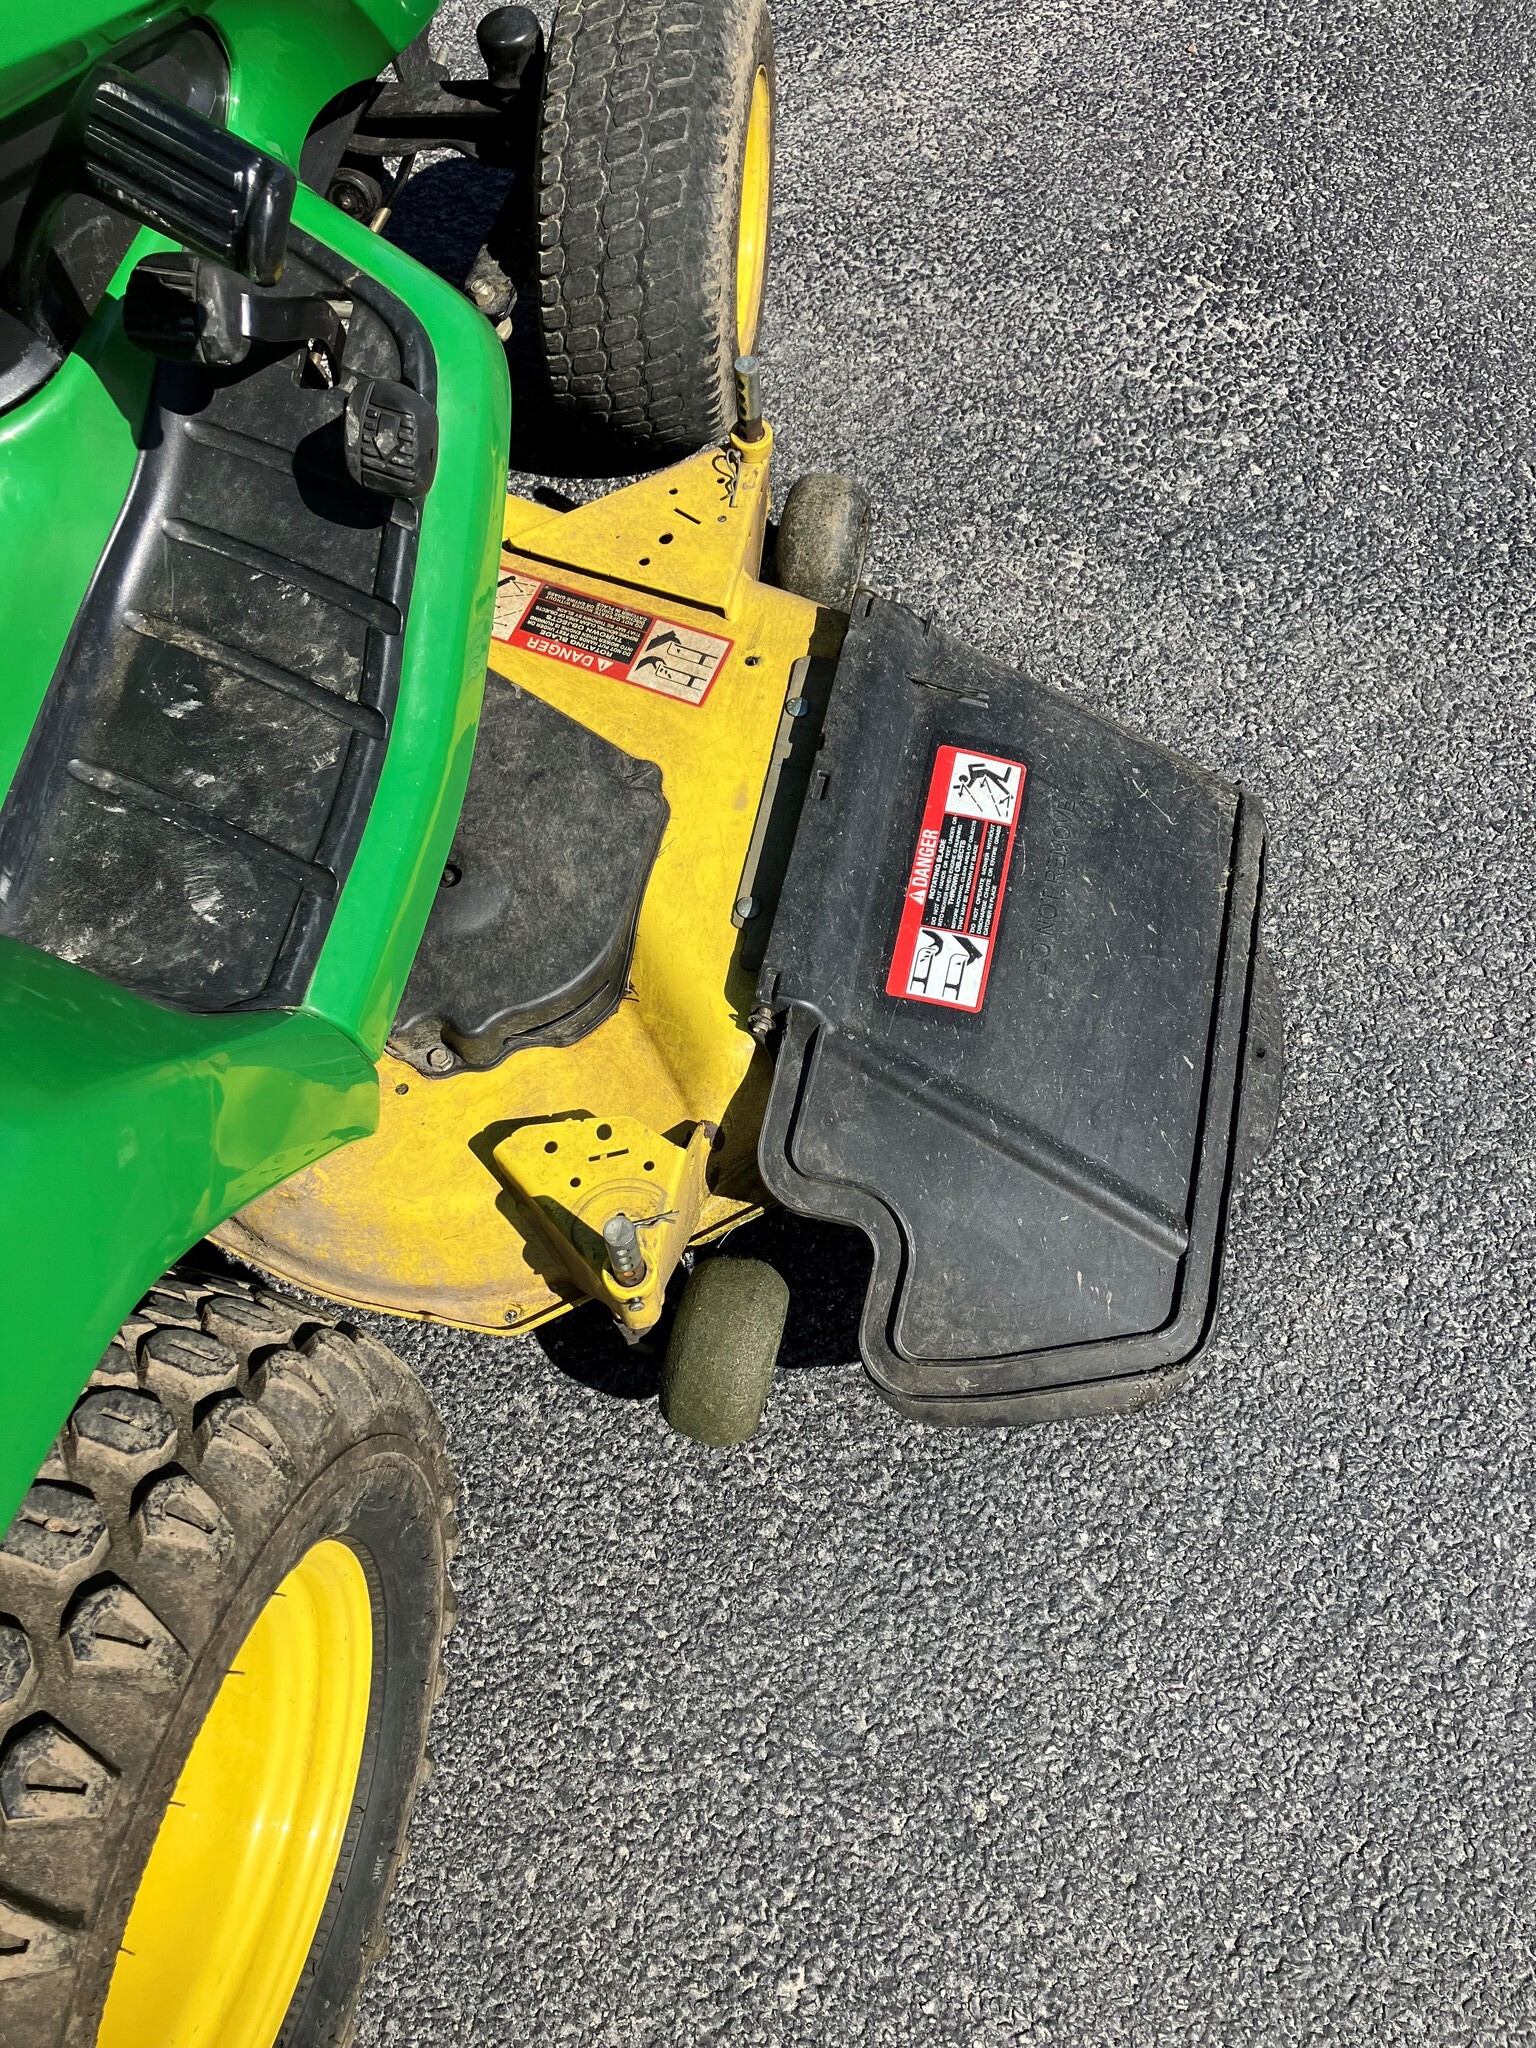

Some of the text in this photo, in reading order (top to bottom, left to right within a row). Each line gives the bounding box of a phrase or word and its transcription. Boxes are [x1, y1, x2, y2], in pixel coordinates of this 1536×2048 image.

[534, 604, 558, 615] OBJECTS
[571, 603, 593, 613] MOWER
[595, 602, 615, 611] PLACE
[529, 615, 554, 626] RUNNING
[565, 614, 579, 622] AREA
[582, 615, 606, 625] THROWN
[593, 610, 621, 622] OPERATE
[535, 622, 555, 631] UNDER
[578, 619, 596, 628] CLEAR
[620, 618, 634, 626] NOT
[544, 614, 623, 642] THROWN OBJECTS
[555, 628, 569, 636] FEET
[560, 625, 581, 635] ENGINE
[626, 629, 641, 637] THAT
[578, 636, 598, 645] HANDS
[580, 631, 598, 640] WHEN
[539, 629, 613, 657] ROTATING BLADE
[597, 637, 620, 647] MOWER
[525, 636, 595, 667] DANGER
[619, 644, 633, 652] INTO
[911, 827, 938, 888] DANGER
[928, 838, 946, 899] ROTATING BLADE
[930, 916, 936, 925] DO
[938, 869, 946, 889] HANDS
[942, 860, 948, 868] OR
[947, 825, 955, 844] UNDER
[951, 816, 957, 825] OR
[940, 891, 948, 913] MOWER
[944, 874, 952, 891] WHEN
[948, 854, 956, 873] ENGINE
[953, 824, 962, 848] RUNNING
[969, 862, 975, 870] BY
[947, 839, 966, 905] THROWN OBJECTS
[950, 907, 959, 929] BEFORE
[968, 819, 976, 843] OBJECTS
[964, 870, 973, 894] THROWN
[969, 923, 976, 933] DO
[975, 877, 985, 904] OPERATE
[980, 852, 990, 875] MOWER
[985, 823, 995, 850] WITHOUT
[976, 825, 1002, 934] DISCHARGE CHUTE OR ENTIRE GRASS
[1027, 799, 1076, 976] DO NOT REMOVE
[962, 894, 968, 902] BE
[982, 909, 992, 935] CATCHER
[989, 884, 997, 902] PLACE
